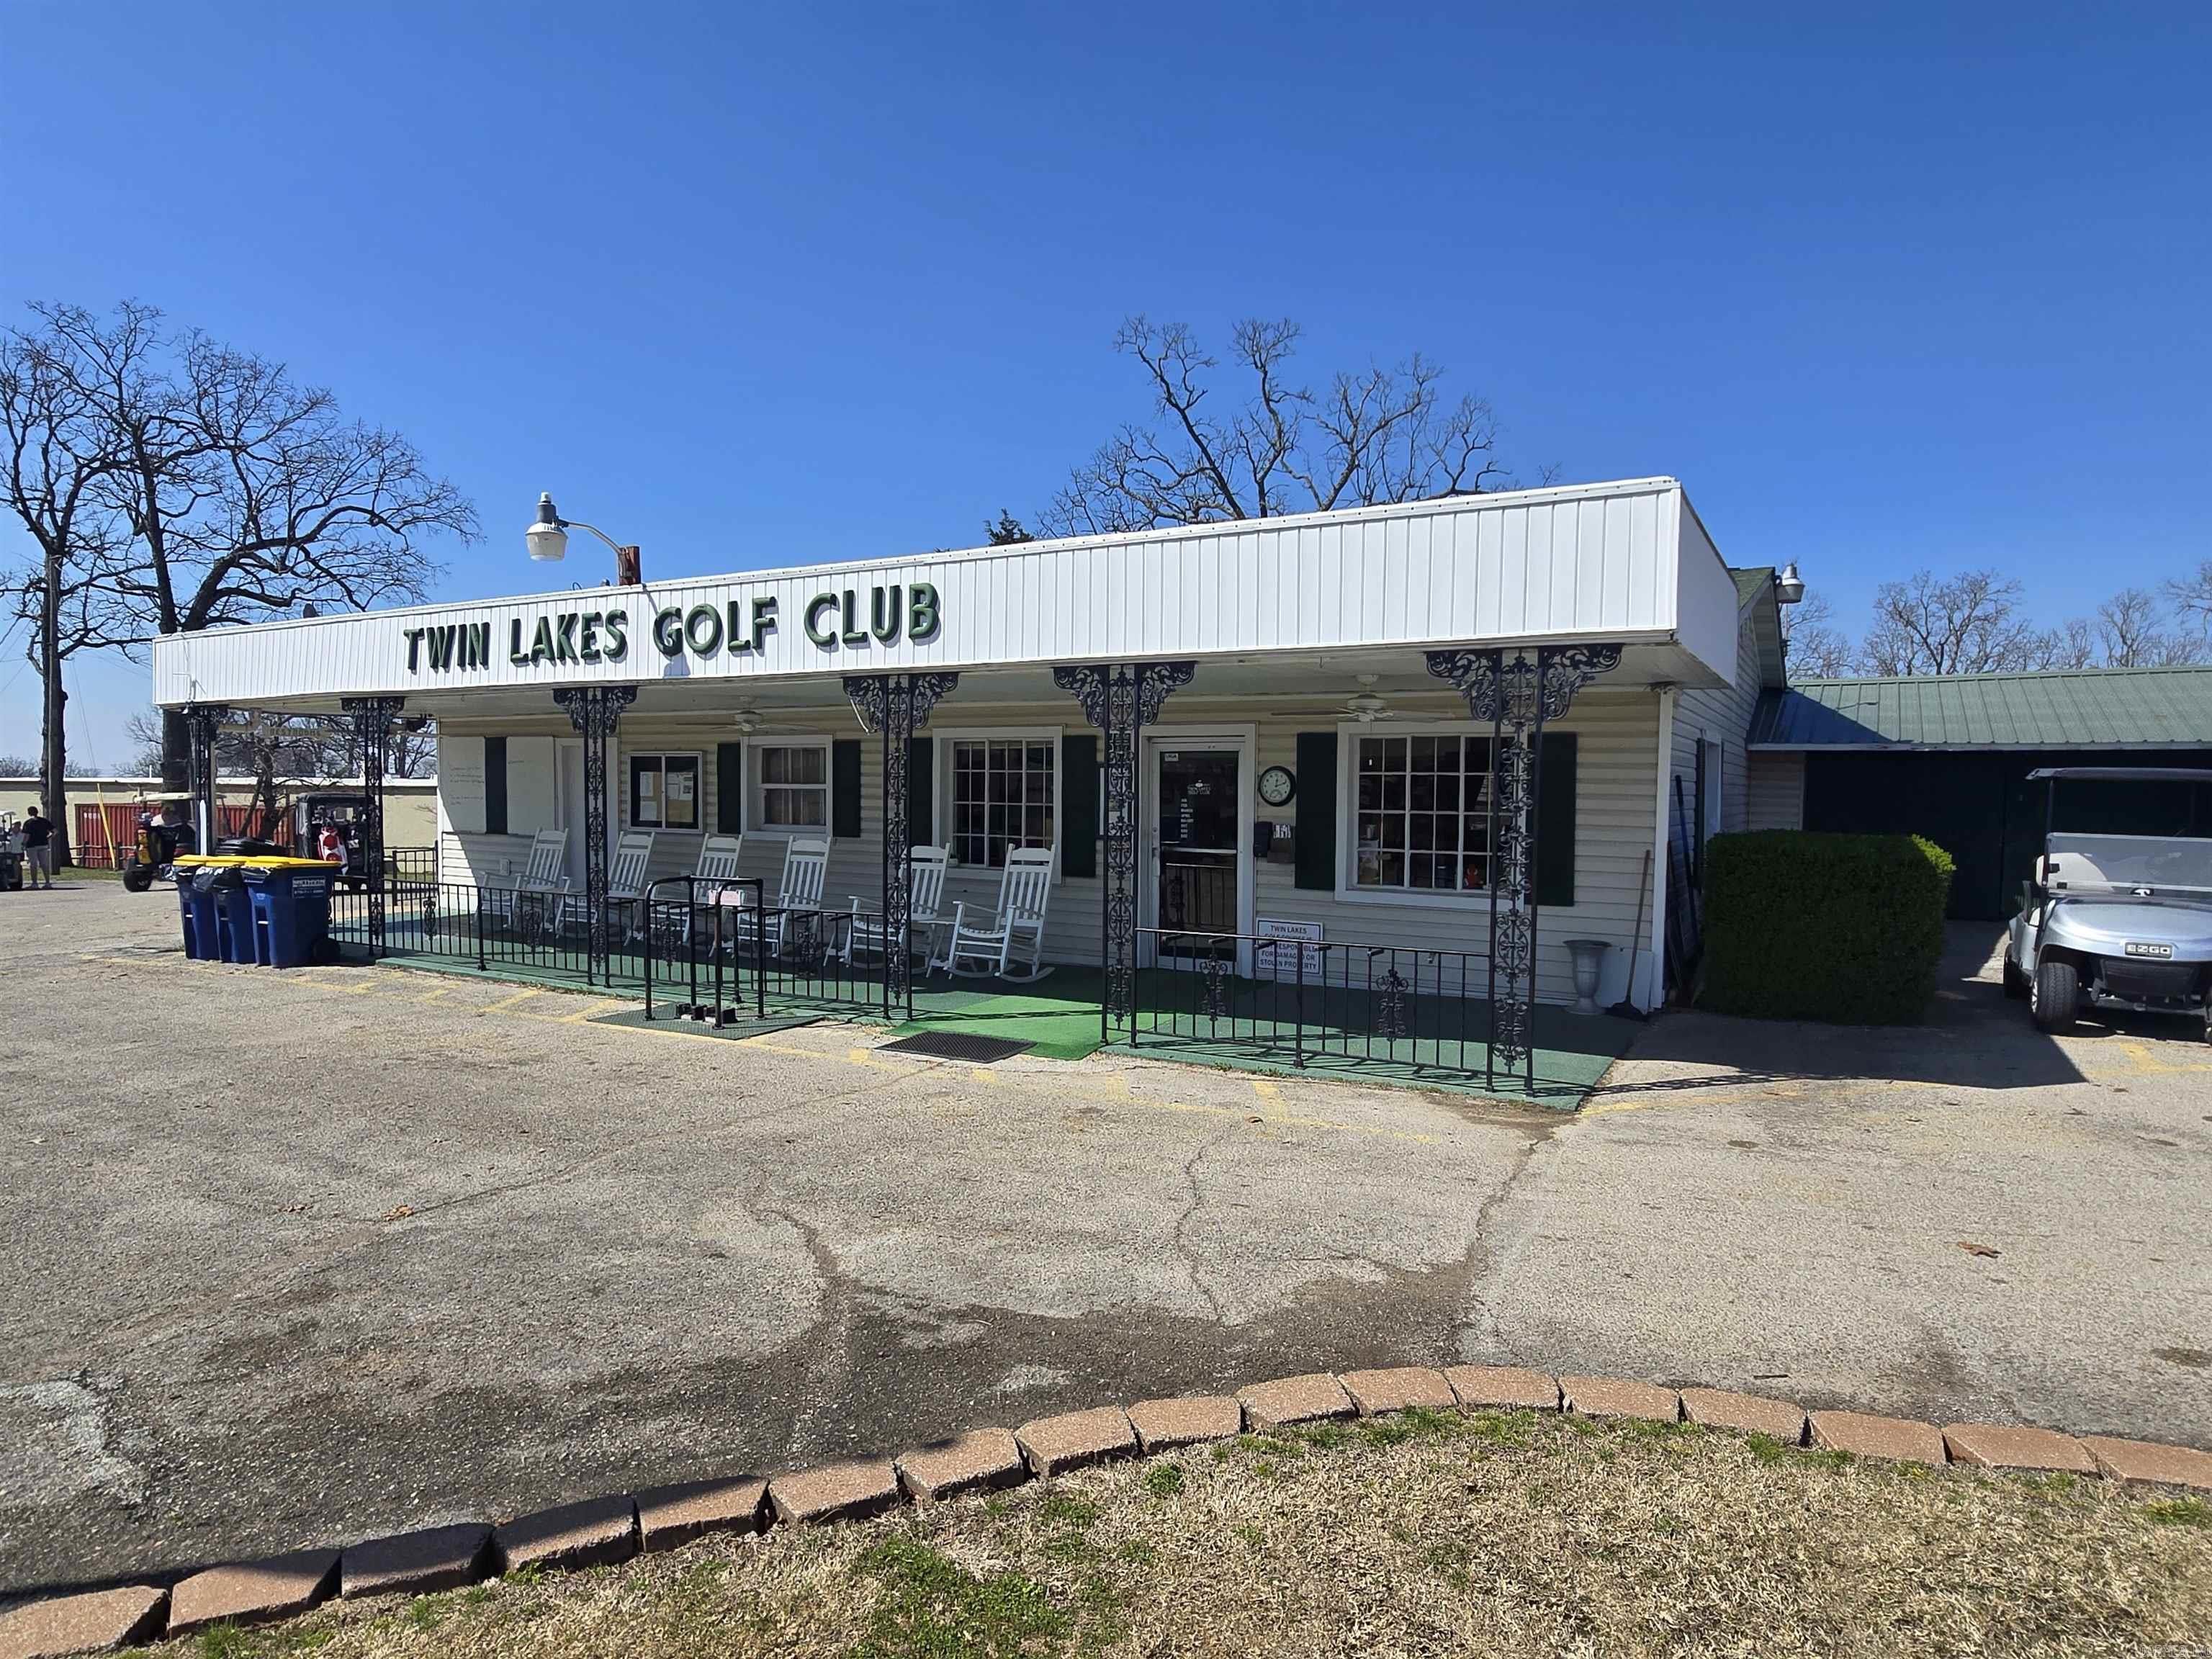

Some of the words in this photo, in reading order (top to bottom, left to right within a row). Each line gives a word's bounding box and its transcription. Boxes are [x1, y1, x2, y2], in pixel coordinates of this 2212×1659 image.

[403, 621, 490, 672] TWIN
[510, 609, 627, 664] LAKES
[652, 595, 776, 656] GOLF
[804, 583, 938, 647] CLUB
[1259, 958, 1283, 967] STOLN
